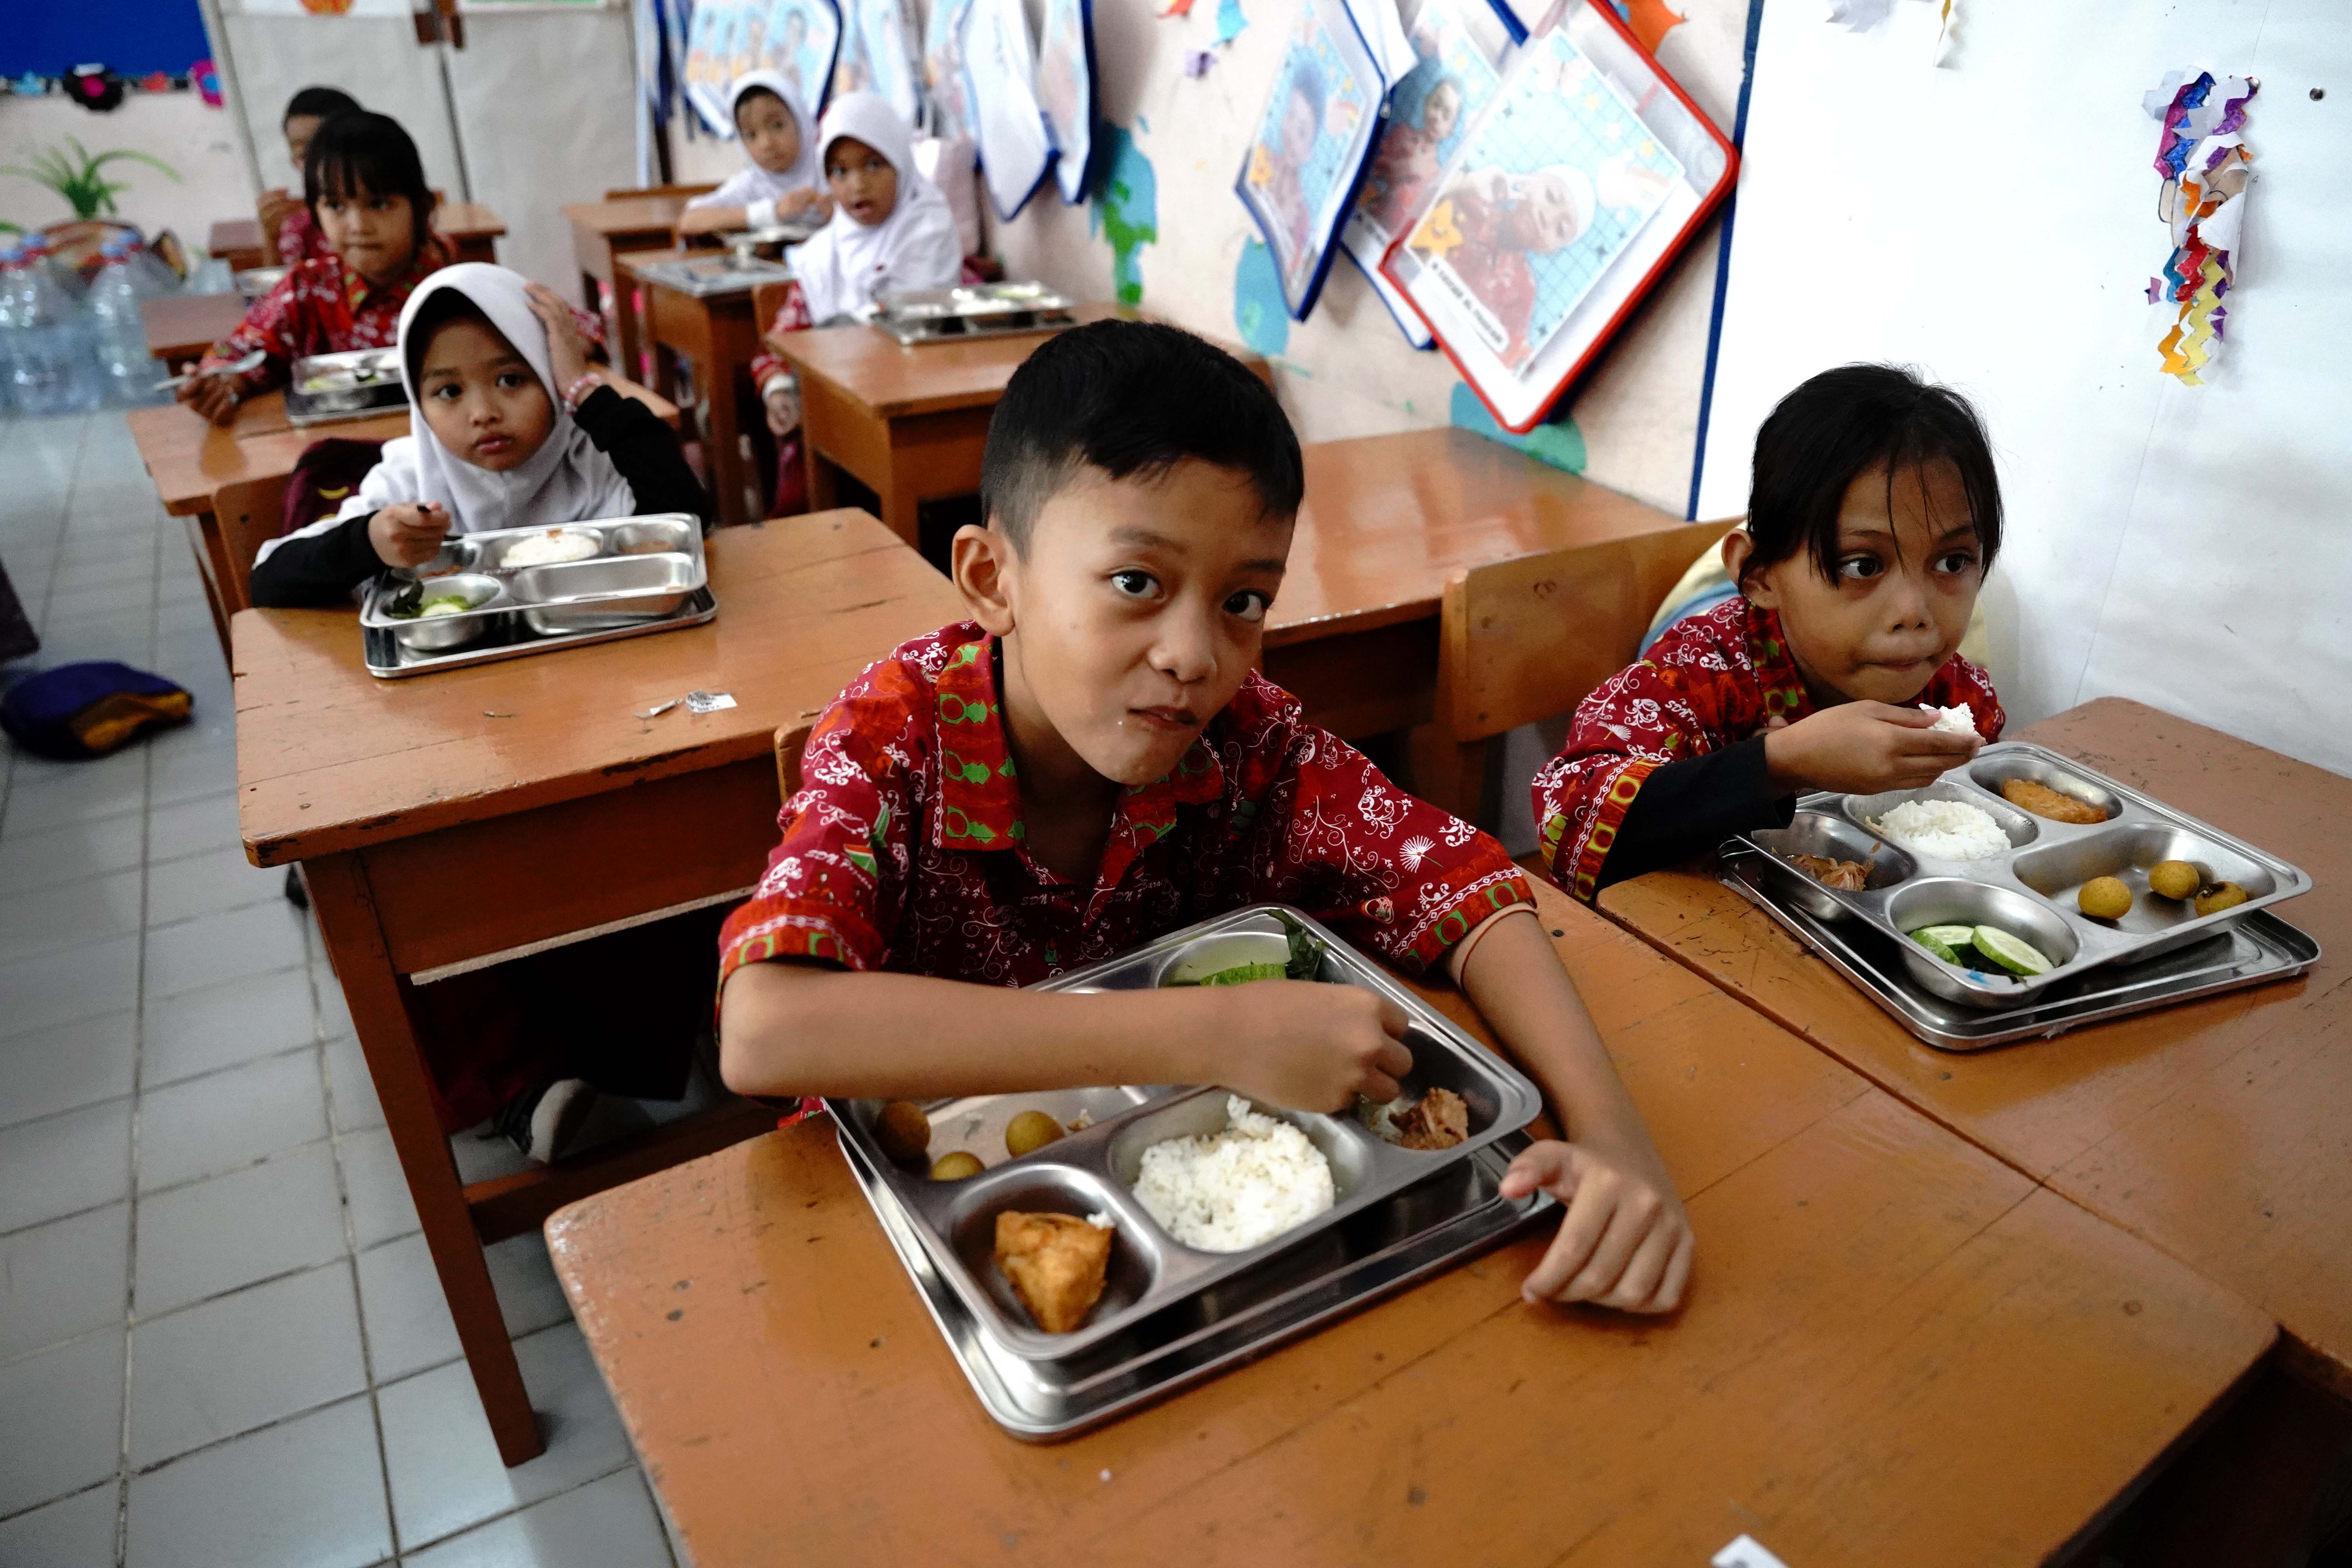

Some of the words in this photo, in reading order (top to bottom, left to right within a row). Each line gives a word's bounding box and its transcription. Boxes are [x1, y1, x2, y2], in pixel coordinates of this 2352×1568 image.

[1665, 700, 1689, 718] SDN
[1361, 762, 1377, 785] SDN
[804, 849, 840, 866] SDN
[1021, 893, 1047, 906] SDN
